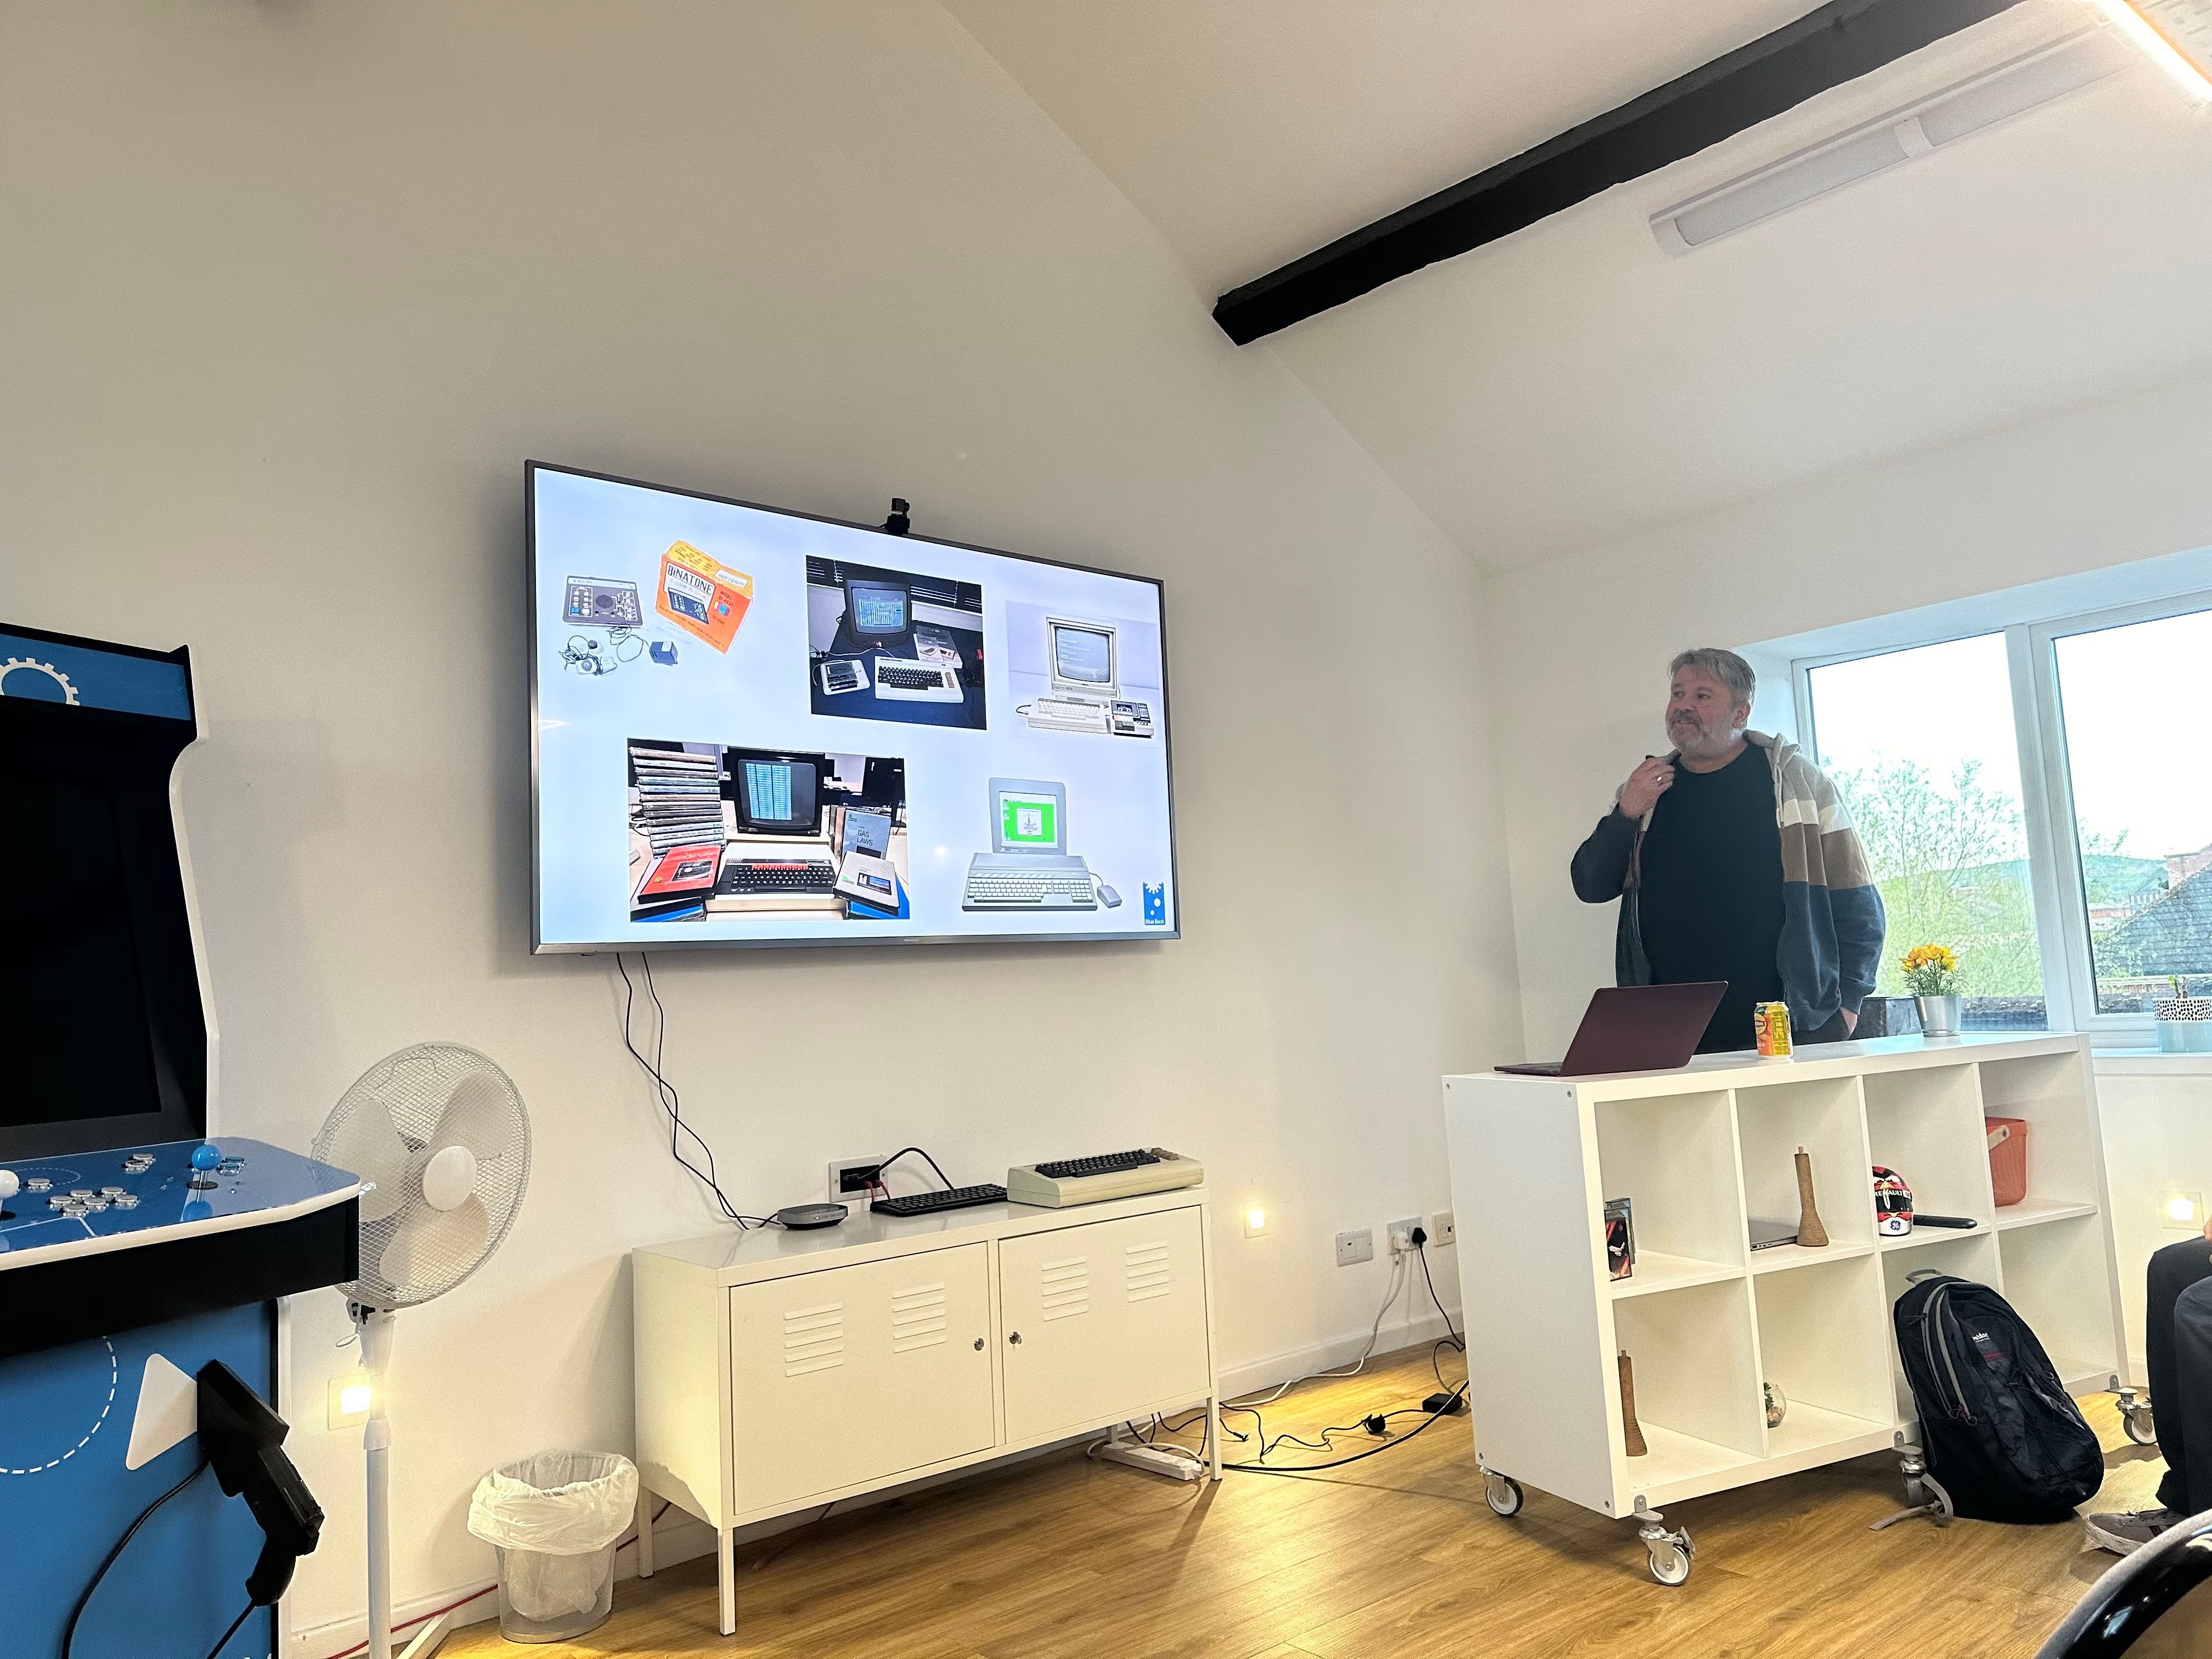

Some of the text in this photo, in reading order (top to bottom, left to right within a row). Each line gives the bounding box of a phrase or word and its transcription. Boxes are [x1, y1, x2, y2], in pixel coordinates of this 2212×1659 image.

[857, 830, 870, 838] GAS
[856, 837, 873, 846] LAWS
[1875, 1188, 1903, 1197] RENAULT
